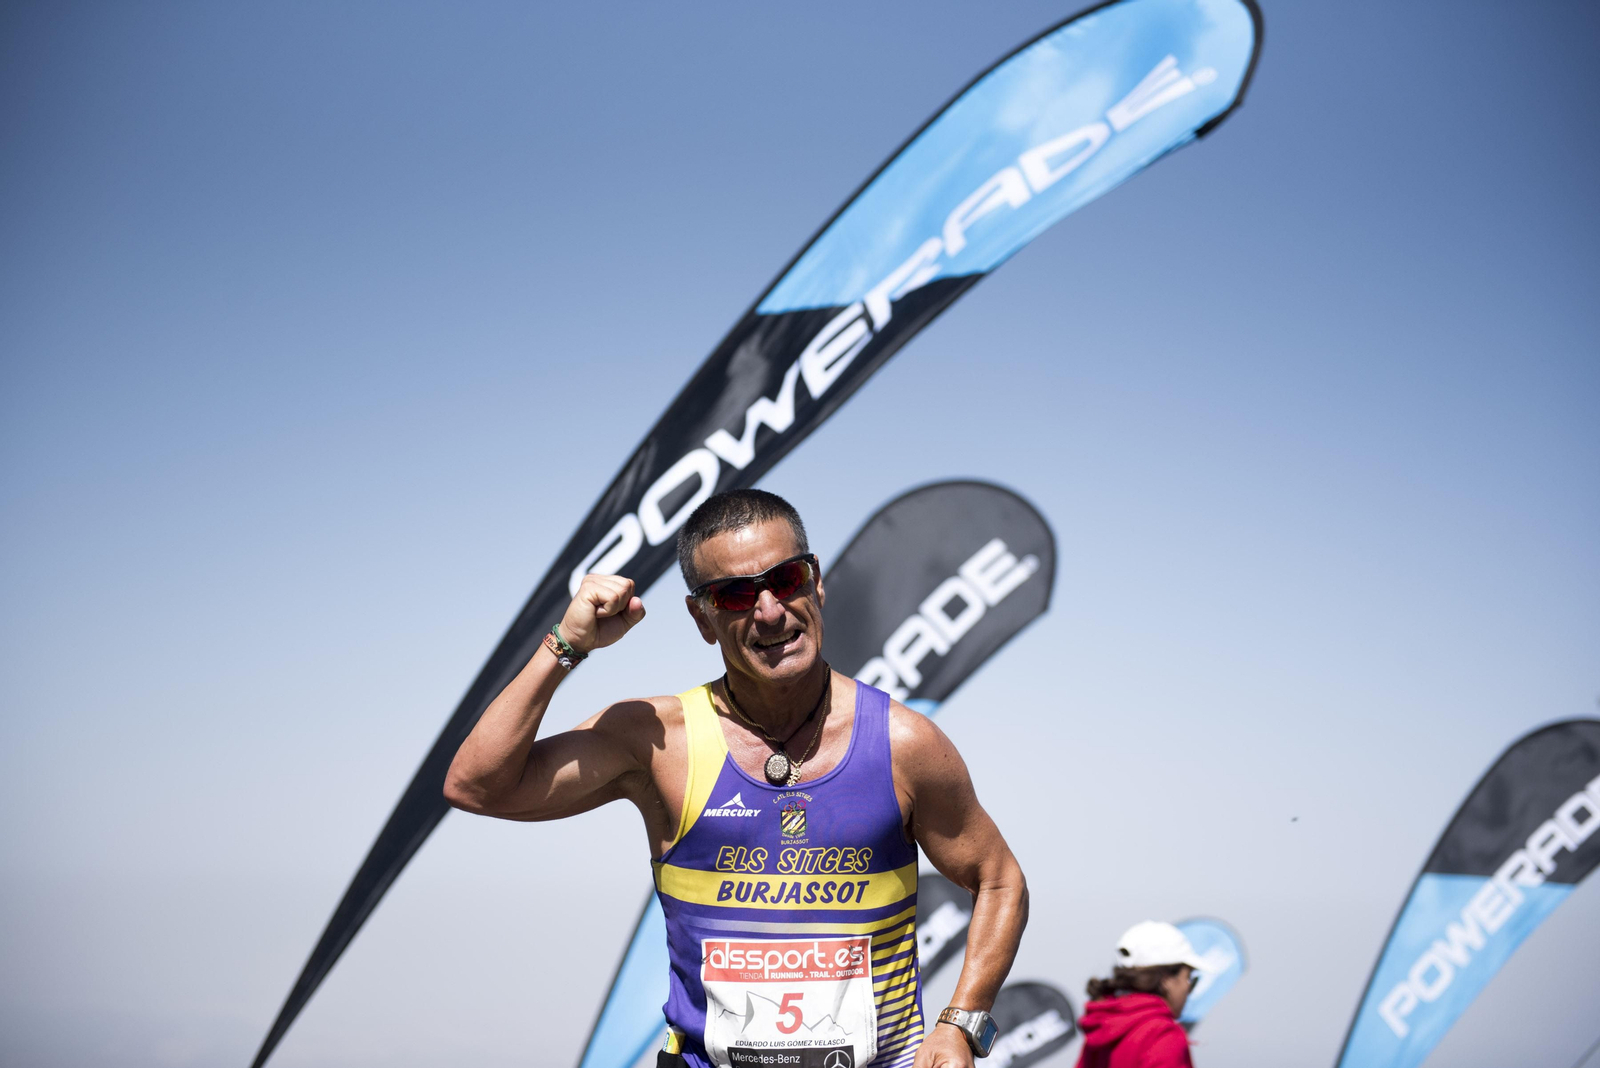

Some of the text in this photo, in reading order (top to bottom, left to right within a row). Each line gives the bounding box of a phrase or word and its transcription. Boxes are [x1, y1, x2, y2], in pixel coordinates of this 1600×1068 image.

[568, 55, 1200, 601] POWERADE
[852, 537, 1037, 703] RADE
[703, 808, 762, 817] MERCURY
[715, 846, 873, 873] ELS SITGES
[716, 880, 870, 905] BURJASSOT
[709, 941, 864, 980] alssport.es
[739, 967, 864, 980] TIENDA RUNNING TRAIL OUTDOOR
[775, 992, 804, 1034] 5
[735, 1040, 768, 1048] EDUARDO
[769, 1040, 785, 1048] LUIS
[814, 1037, 846, 1046] VELASCO
[731, 1051, 801, 1064] Mercedes-Benz
